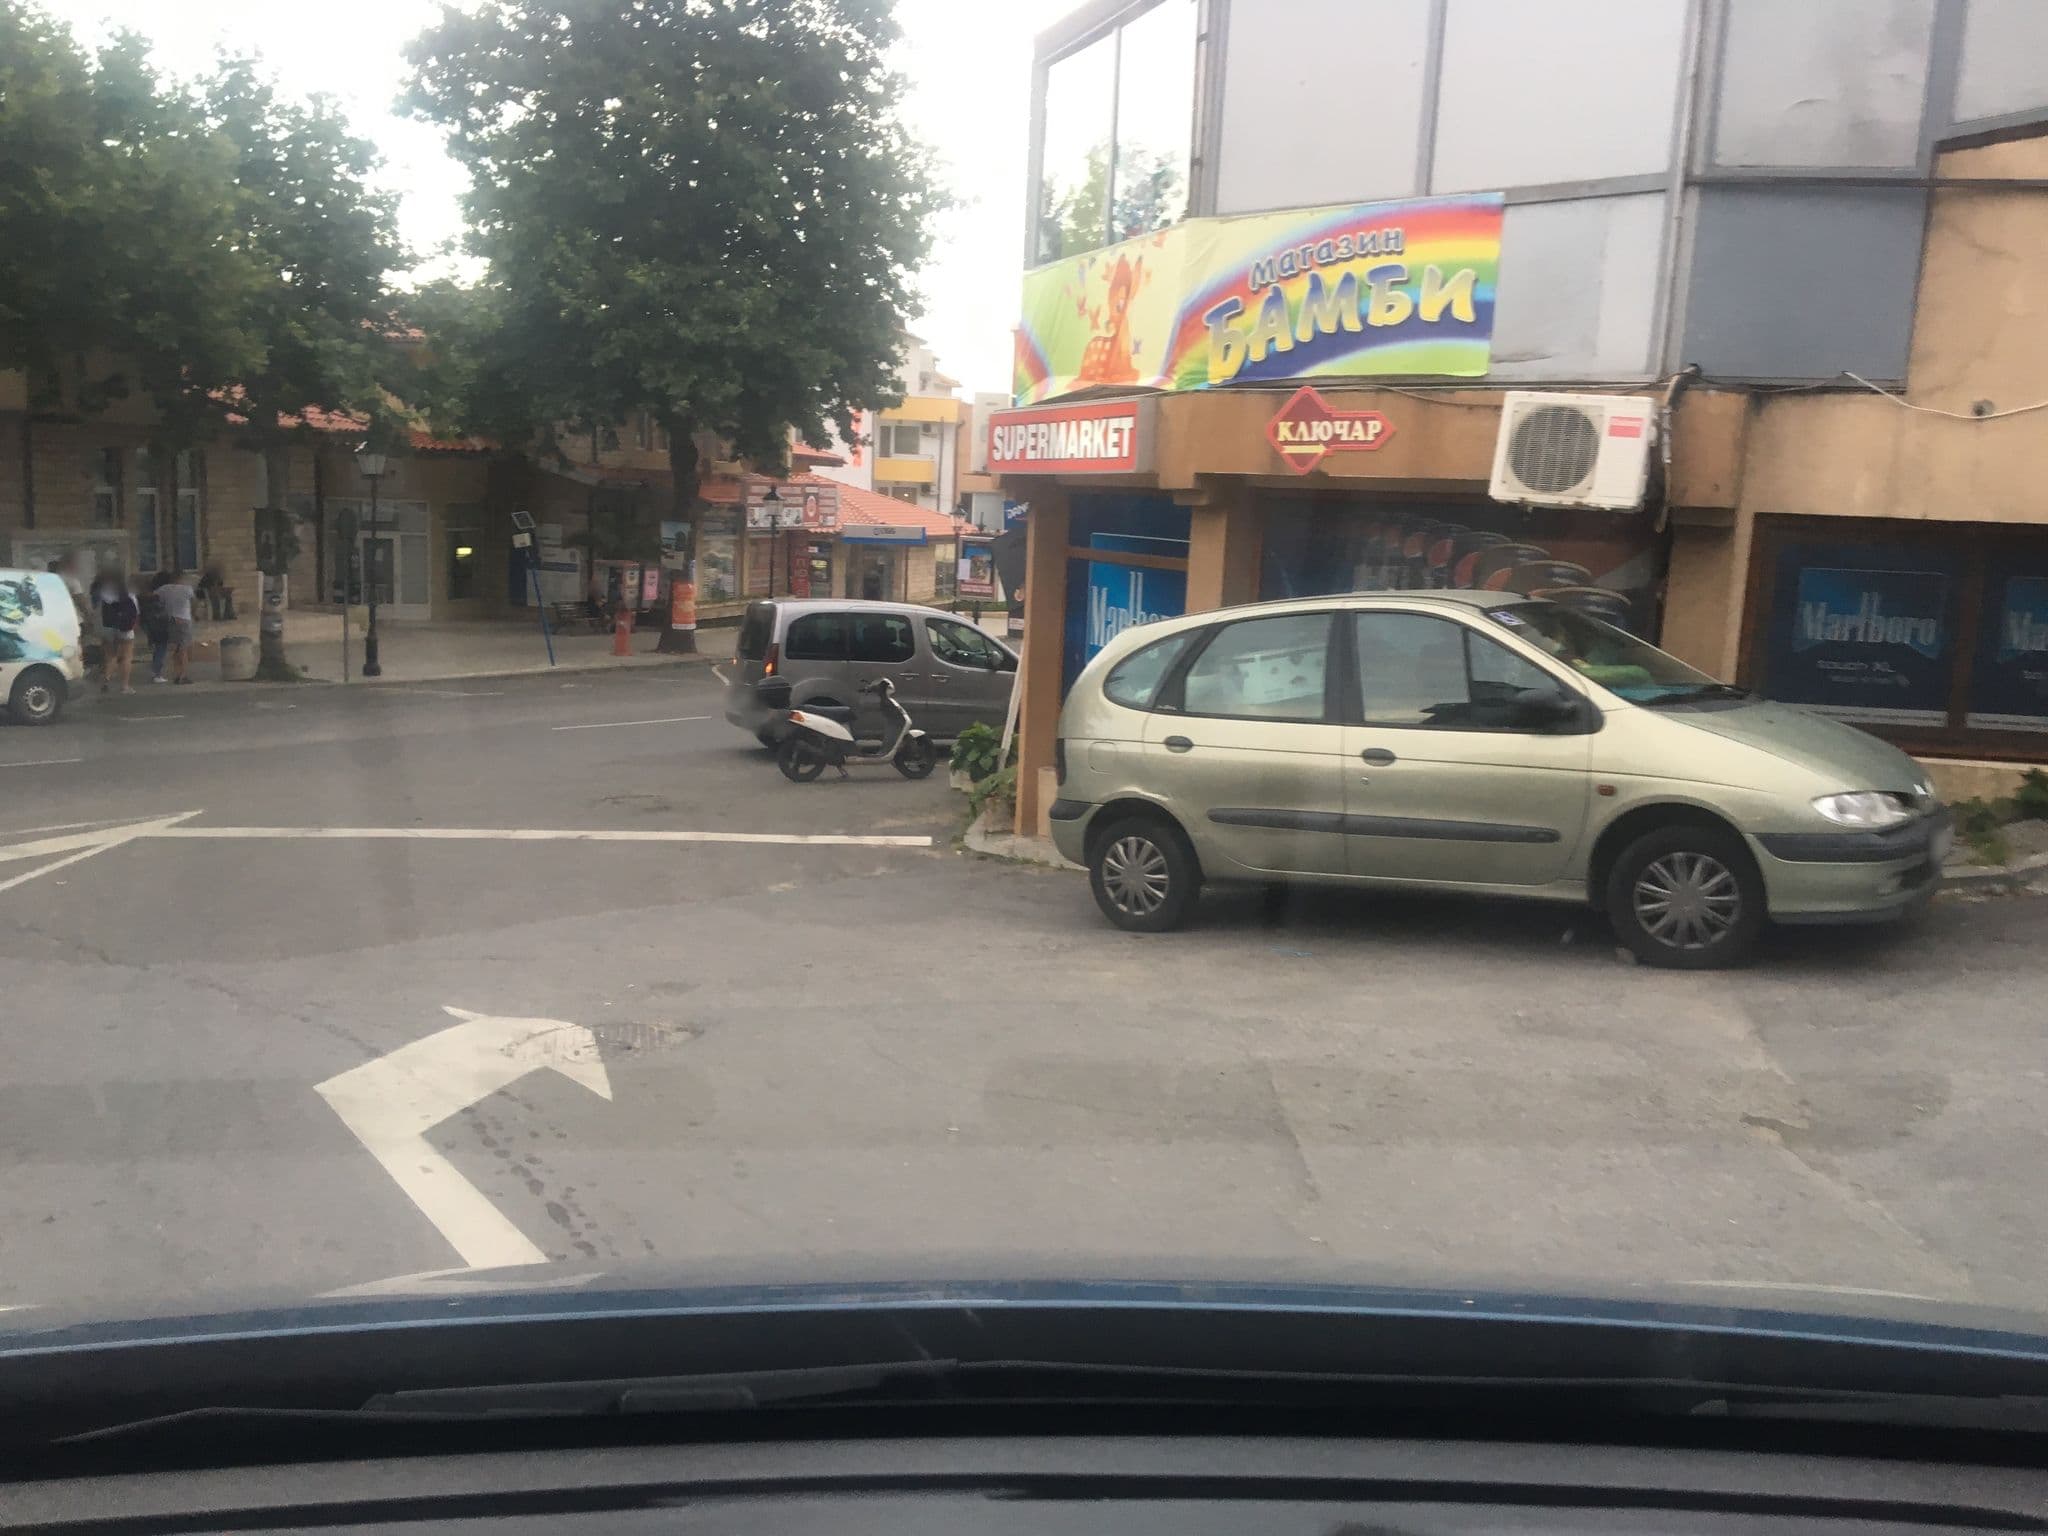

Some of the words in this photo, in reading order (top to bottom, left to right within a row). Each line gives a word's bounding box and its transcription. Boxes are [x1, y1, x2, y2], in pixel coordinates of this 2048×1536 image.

[1204, 264, 1477, 384] БАМБИ
[993, 416, 1134, 460] SUPERMARKET
[1278, 420, 1382, 441] КЛЮЧАР
